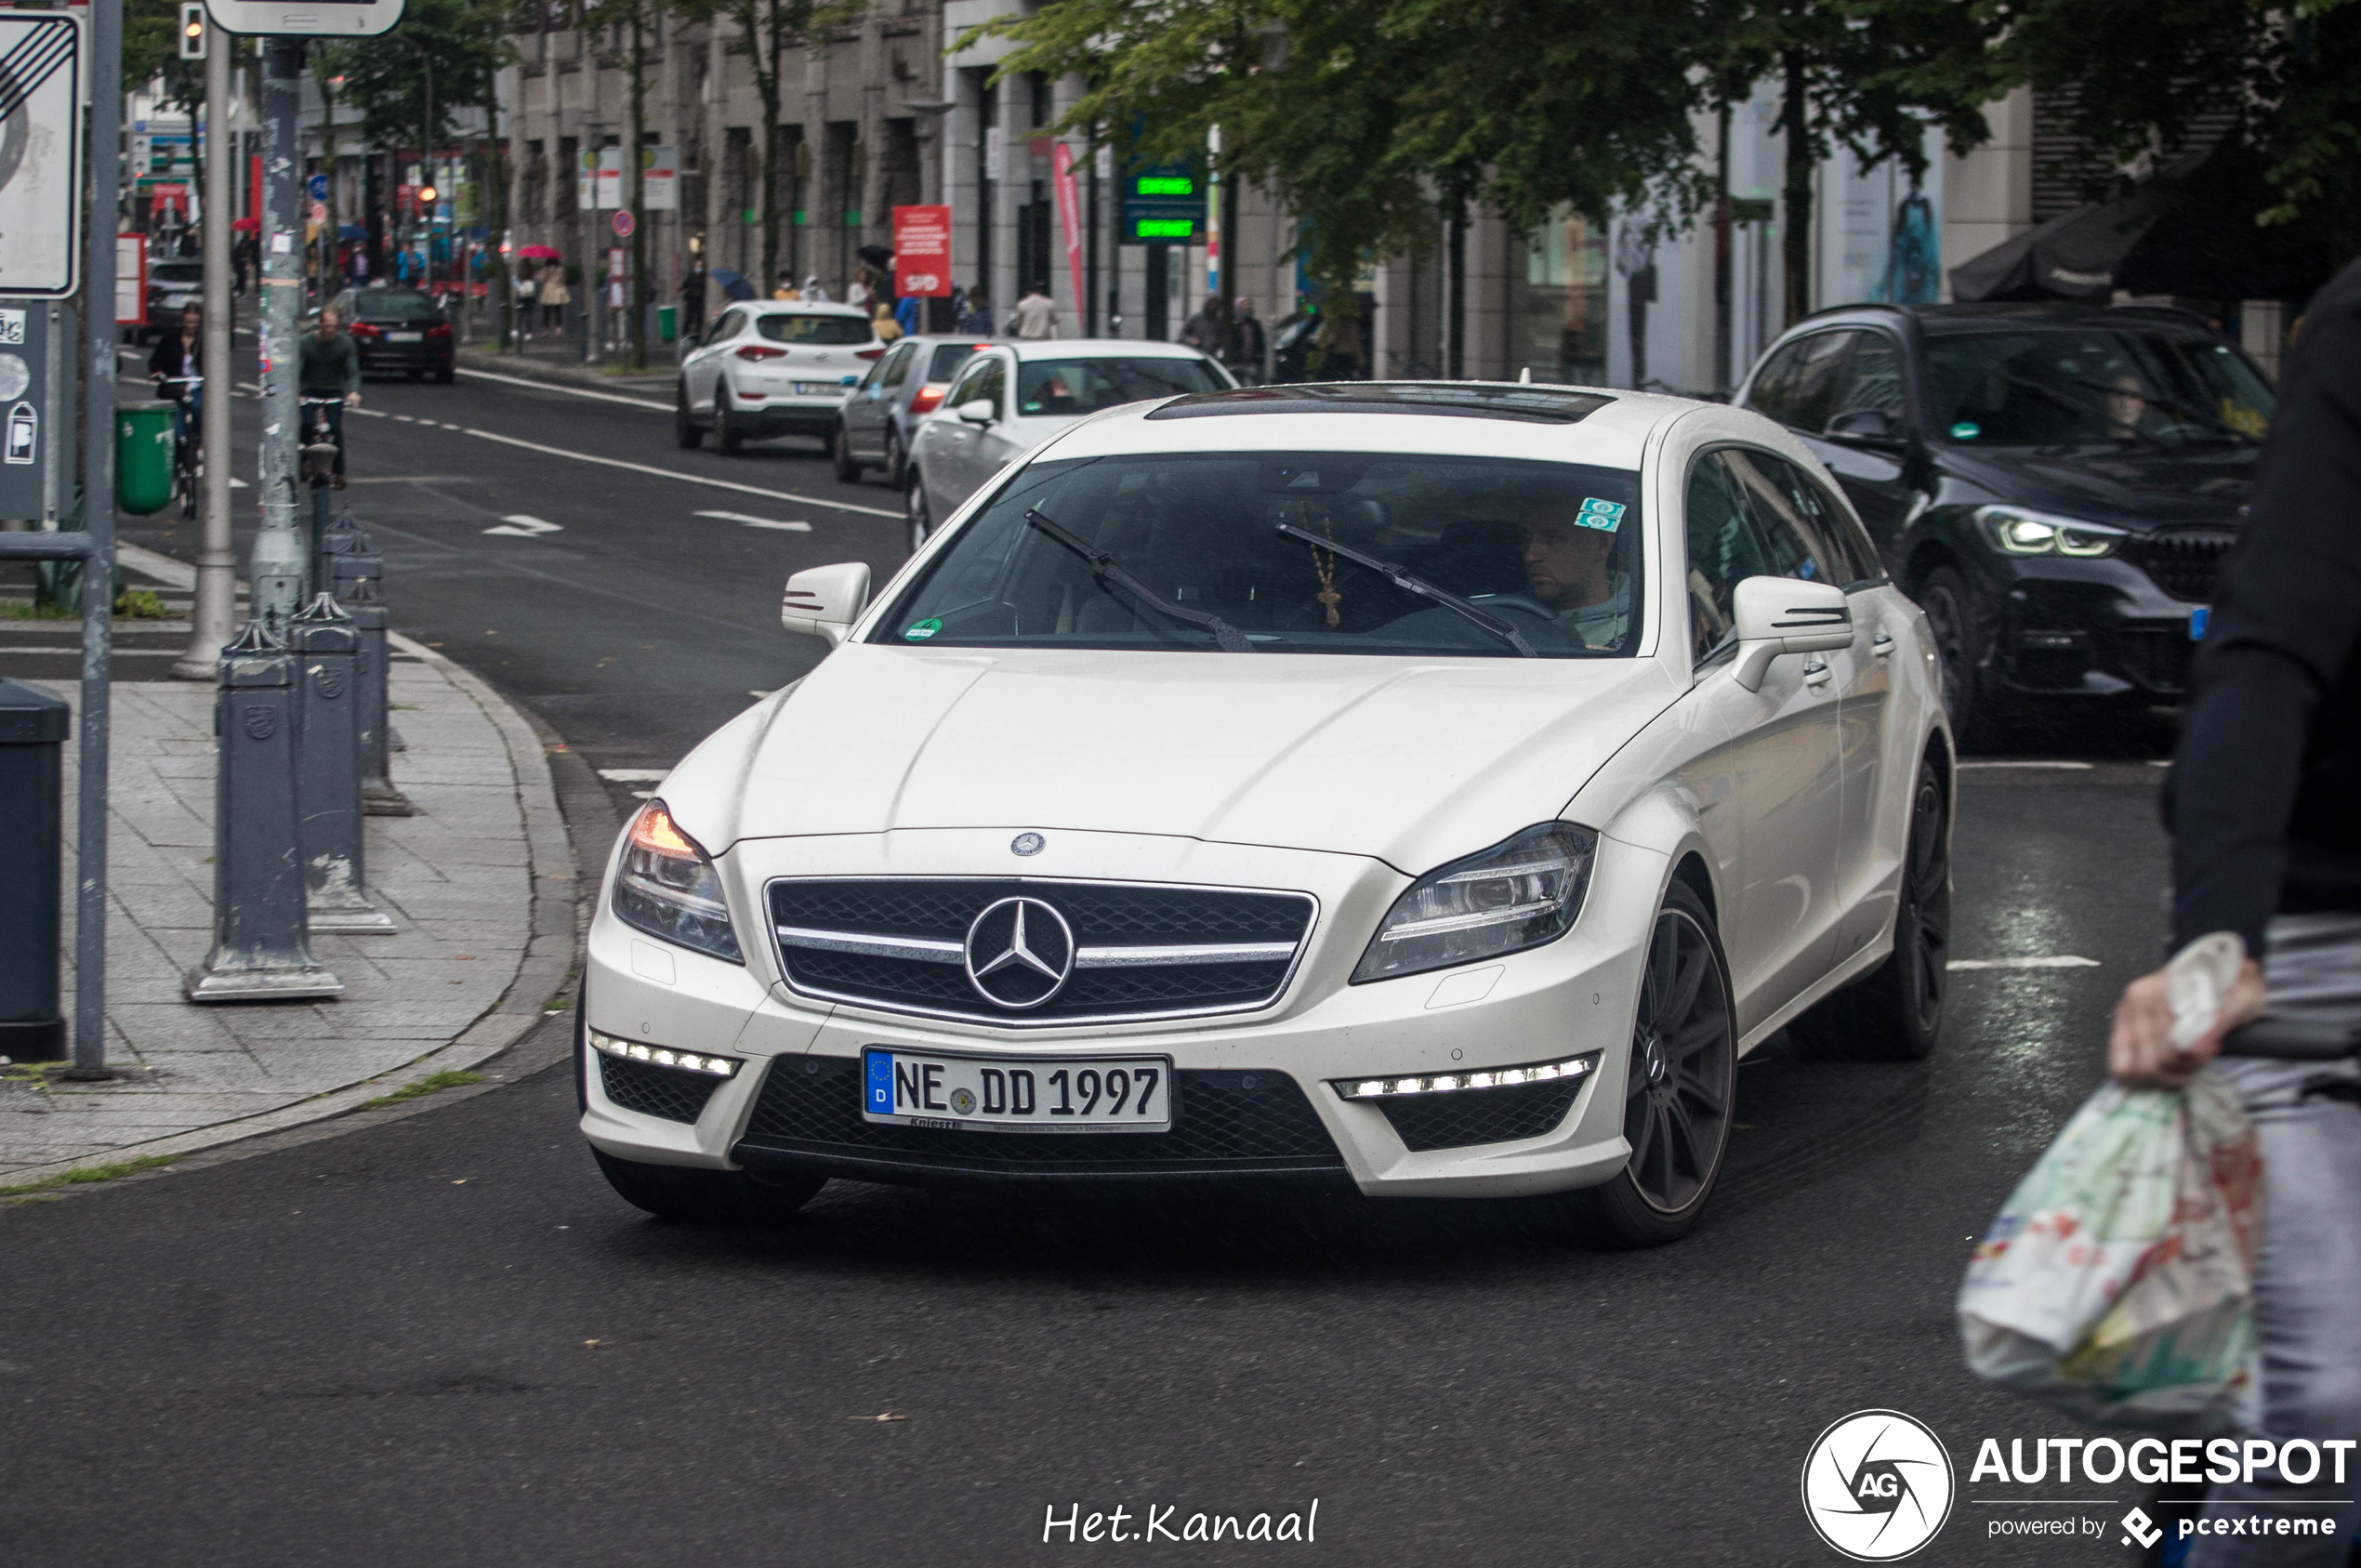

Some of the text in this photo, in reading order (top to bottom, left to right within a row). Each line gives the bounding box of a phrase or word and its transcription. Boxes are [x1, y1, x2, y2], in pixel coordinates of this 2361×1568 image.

[895, 1060, 1159, 1116] NE DD 1997
[876, 1088, 887, 1102] D
[910, 1118, 952, 1129] Kniest
[1085, 1125, 1122, 1133] Dormagen
